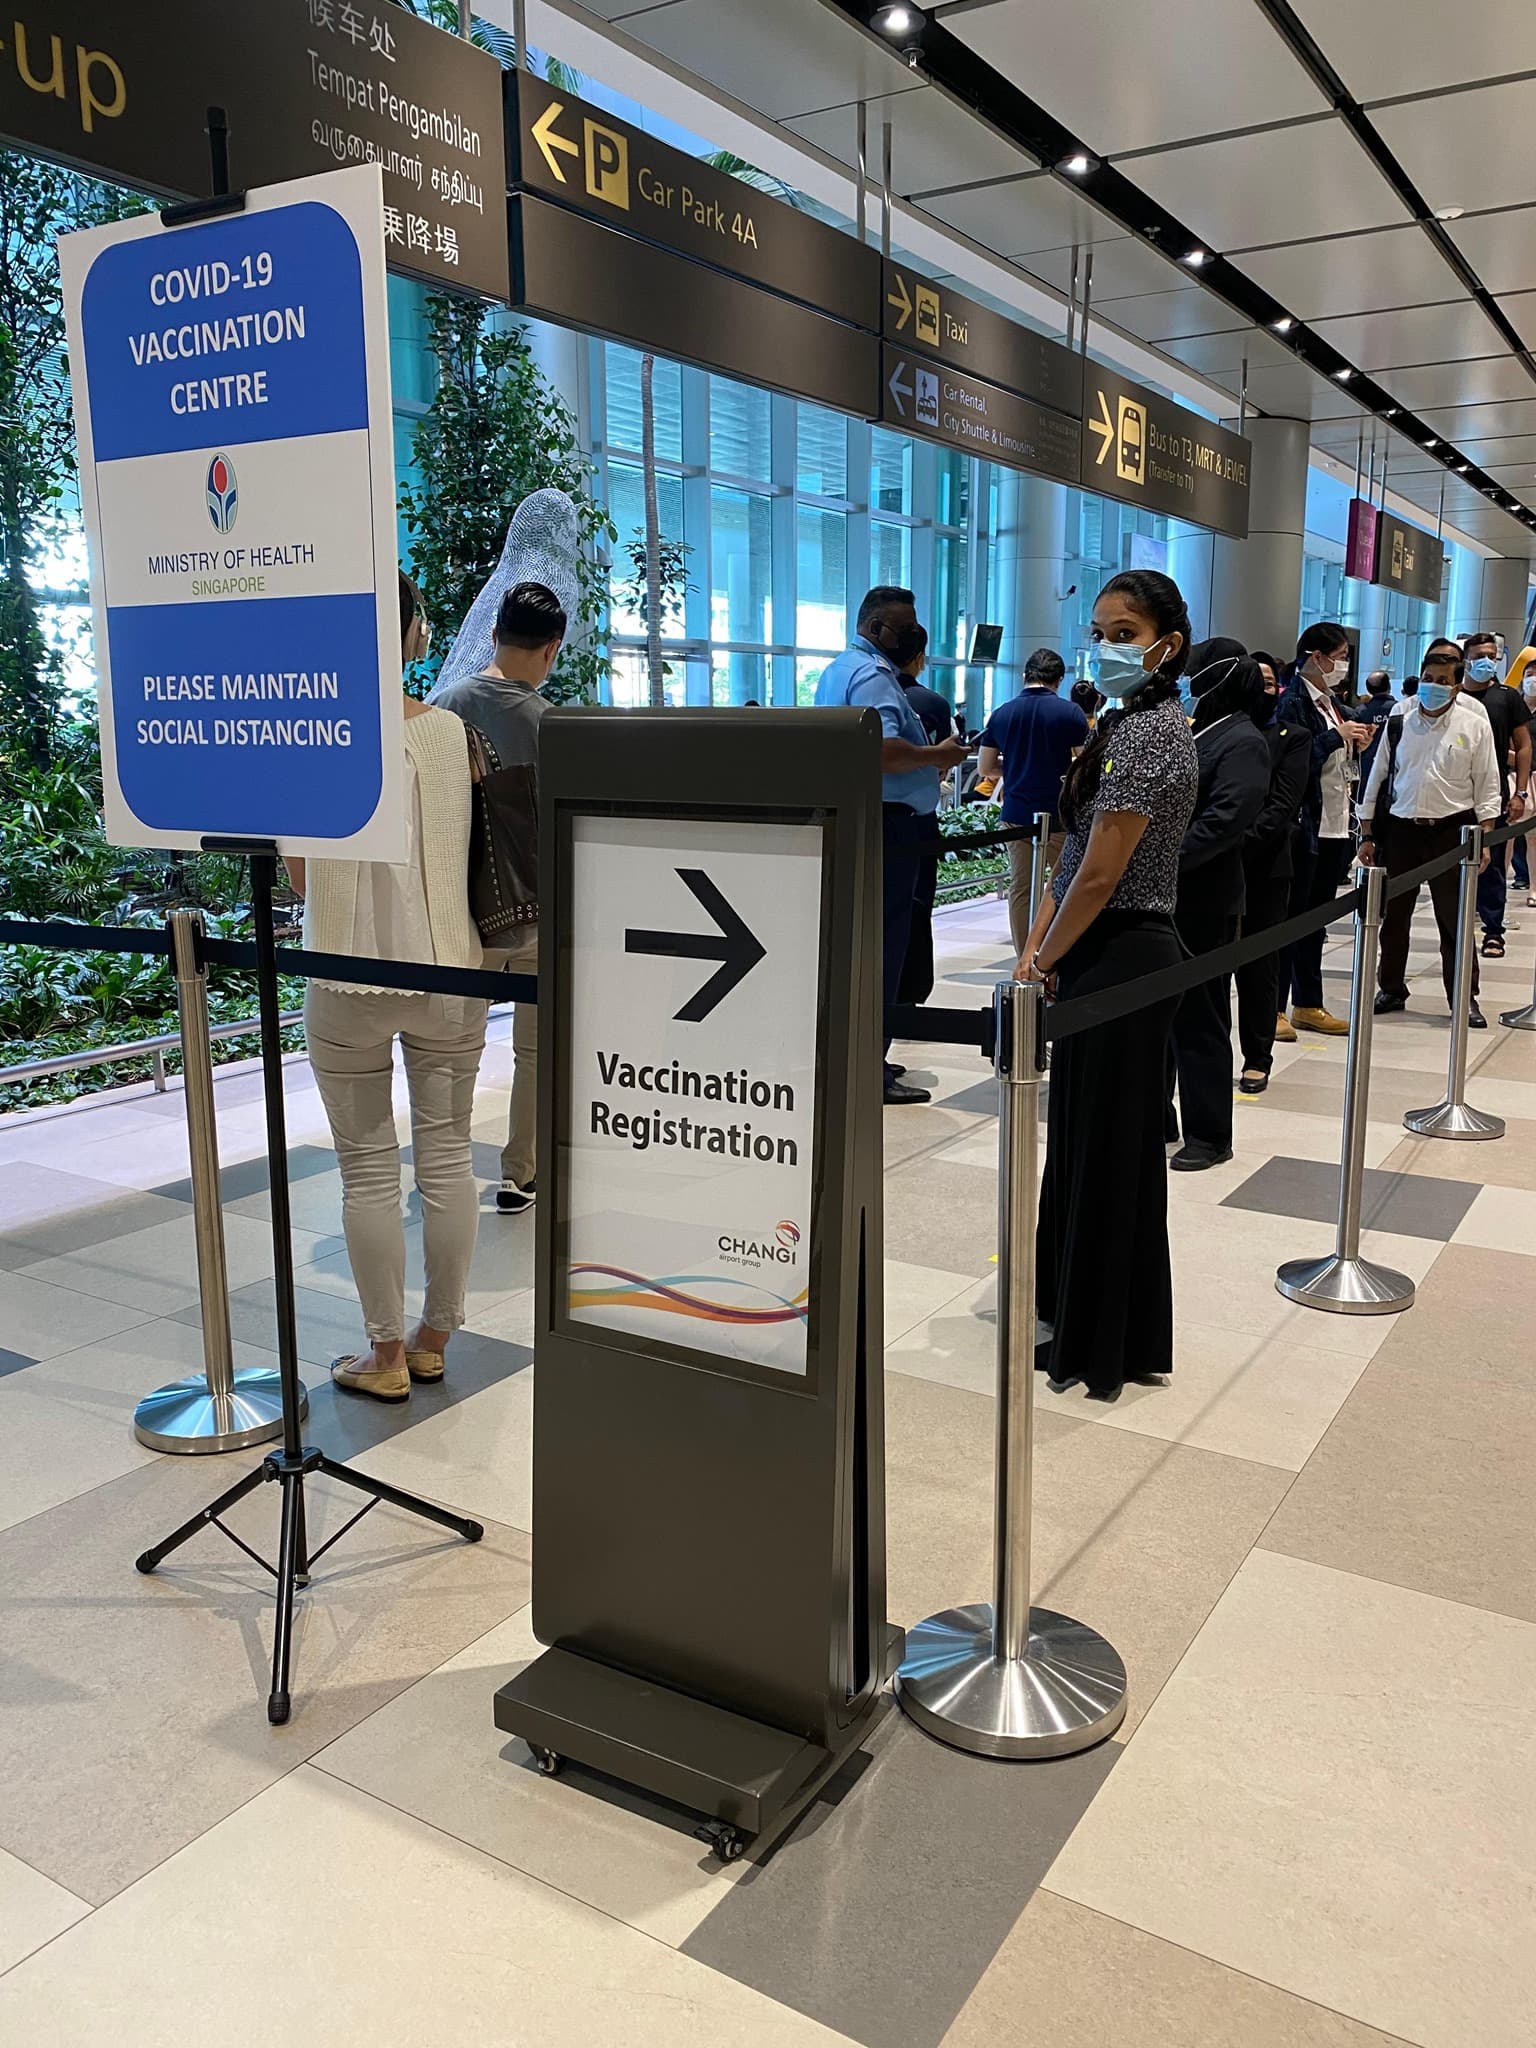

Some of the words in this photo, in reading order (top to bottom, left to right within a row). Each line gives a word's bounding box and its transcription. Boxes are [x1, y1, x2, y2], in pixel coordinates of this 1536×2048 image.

[0, 21, 126, 134] up
[307, 48, 374, 111] Tempat
[379, 81, 481, 157] Pengambilan
[593, 130, 620, 191] P
[638, 168, 674, 209] Car
[681, 186, 725, 235] Park
[731, 212, 759, 249] 4A
[150, 251, 273, 306] COVID-19
[128, 305, 306, 366] VACCINATION
[944, 312, 968, 345] Taxi
[170, 370, 269, 415] CENTRE
[943, 383, 958, 401] Car
[960, 388, 987, 415] Rental,
[943, 412, 960, 435] City
[961, 418, 990, 442] Shuttle
[991, 429, 997, 444] &
[999, 431, 1036, 457] Limousine
[1149, 423, 1167, 452] Bus
[1169, 433, 1179, 457] to
[1181, 437, 1194, 467] T3,
[1195, 443, 1215, 472] MRT
[1215, 453, 1222, 475] &
[1223, 457, 1248, 486] JEWEL
[1148, 459, 1176, 483] (Transfer
[1176, 472, 1184, 487] to
[148, 551, 219, 575] MINISTRY
[224, 550, 245, 569] OF
[250, 544, 315, 567] HEALTH
[192, 576, 265, 596] SINGAPORE
[143, 674, 215, 701] PLEASE
[222, 672, 338, 700] MAINTAIN
[136, 719, 208, 745] SOCIAL
[214, 719, 352, 747] DISTANCING
[597, 1051, 794, 1112] Vaccination
[591, 1101, 798, 1166] Registration
[718, 1235, 796, 1265] CHANGI
[719, 1253, 740, 1263] airport
[741, 1258, 761, 1268] group
